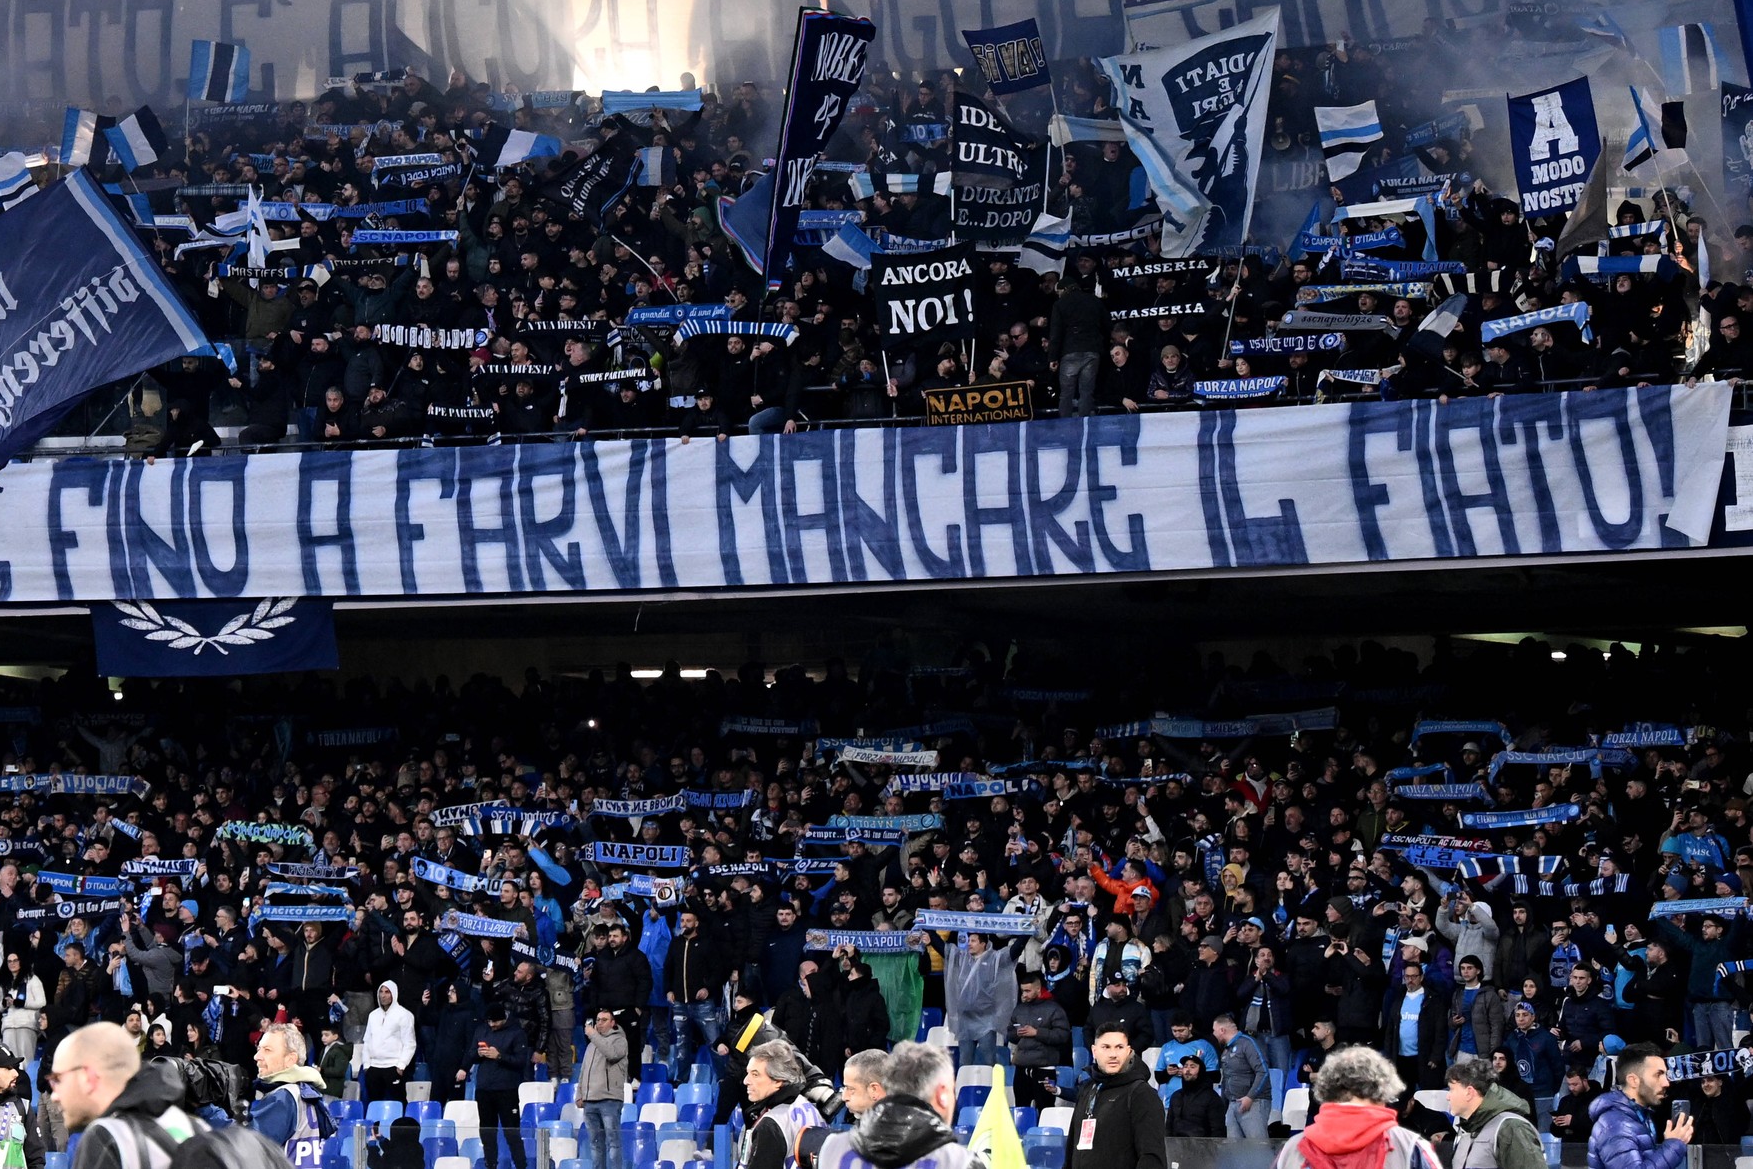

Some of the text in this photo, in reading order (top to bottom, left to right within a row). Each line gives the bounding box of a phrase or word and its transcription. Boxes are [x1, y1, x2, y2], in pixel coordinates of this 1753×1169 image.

[1000, 36, 1044, 78] VA!
[237, 103, 269, 114] NAPOLI
[913, 126, 926, 139] 10
[1529, 91, 1579, 161] A
[1530, 156, 1585, 185] MODO
[1379, 172, 1457, 188] FORZA NAPOLI
[960, 185, 1040, 206] DURANTE
[1523, 182, 1587, 211] NOSTR
[375, 230, 443, 242] NAPOLI
[1311, 232, 1386, 247] CAMPIONI D'ITALIA
[230, 266, 284, 278] MASTIFFS
[880, 258, 972, 286] ANCORA
[1112, 261, 1209, 279] MASSERIA
[640, 308, 670, 321] guardia
[1109, 302, 1206, 321] MASSERIA
[1489, 303, 1579, 335] NAPOLI
[537, 319, 597, 331] TUA DIFESA!
[1301, 315, 1373, 326] sscnapoli1926
[490, 364, 552, 376] TUA DIFESA!
[579, 368, 647, 383] STIRPE PARTENOPEA
[1196, 376, 1282, 393] FORZA NAPOLI
[928, 388, 1025, 412] NAPOLI
[930, 408, 1029, 425] INTERNATIONAL
[49, 453, 250, 601] FINO
[297, 447, 361, 598] A
[396, 437, 679, 595] FARVI
[714, 413, 1151, 588] MANCARE
[1197, 407, 1310, 568] IL
[1348, 383, 1693, 562] FIATO!
[319, 732, 347, 746] FORZA
[1606, 729, 1679, 744] FORZA NAPOLI
[854, 751, 924, 764] FORZA NAPOLI
[1506, 749, 1587, 762] SSC NAPOLI
[490, 809, 517, 821] 1926
[520, 809, 559, 824] Napoli
[227, 822, 264, 836] FORZA
[850, 819, 893, 828] NAPOLI
[1391, 835, 1472, 849] SSC NAPOLI AC MILAN
[602, 842, 678, 862] NAPOLI
[708, 862, 769, 875] SSC NAPOLI
[41, 875, 117, 892] CAMPIONI D'ITALIA
[427, 863, 500, 894] 10 10
[17, 906, 46, 920] Sempre
[262, 906, 303, 916] MAGICO
[459, 915, 484, 930] FORZA
[928, 915, 1019, 930] FORZA NAPOLI
[830, 934, 903, 948] FORZA NAPOLI
